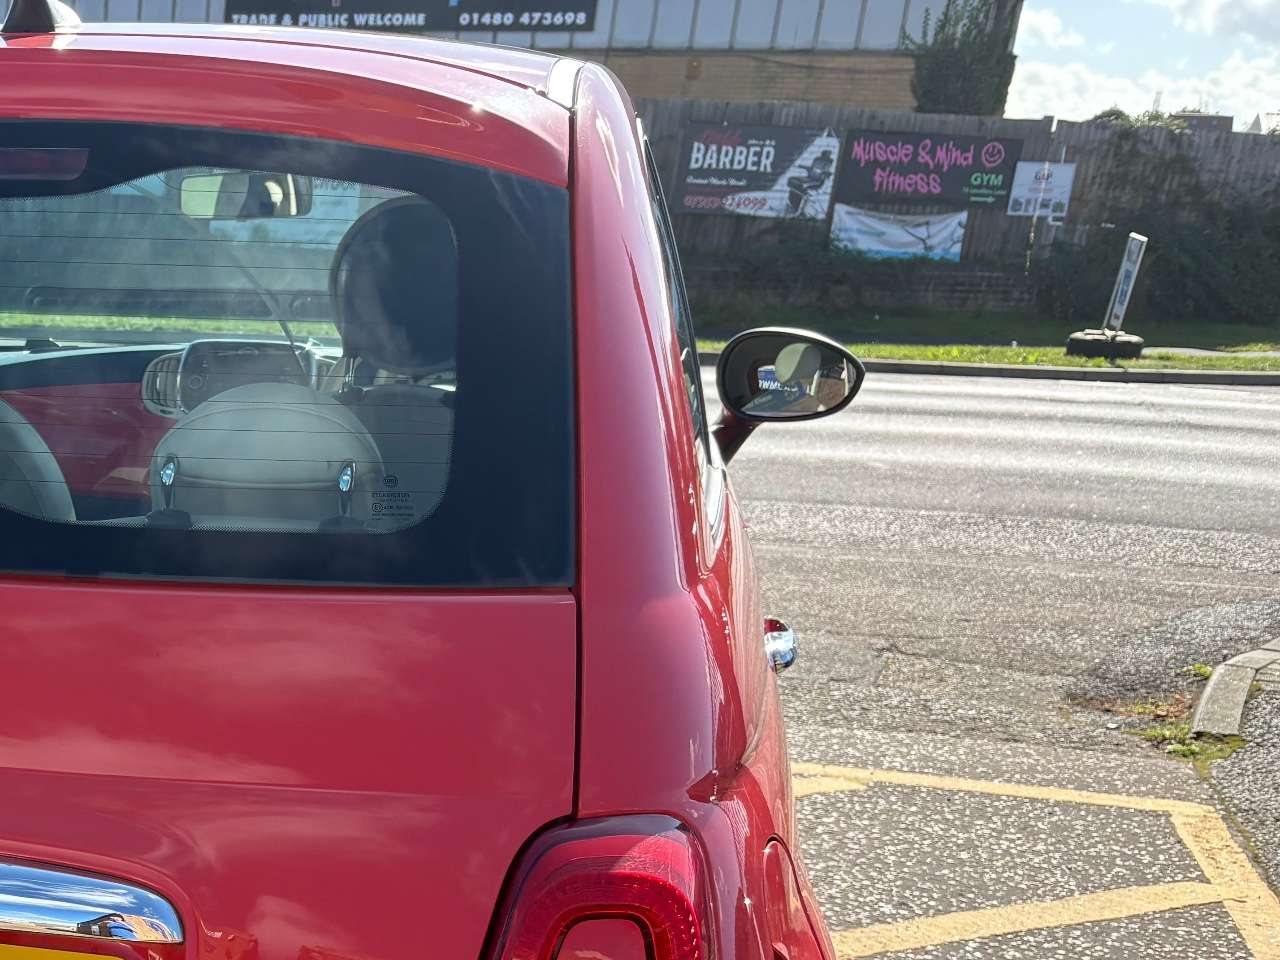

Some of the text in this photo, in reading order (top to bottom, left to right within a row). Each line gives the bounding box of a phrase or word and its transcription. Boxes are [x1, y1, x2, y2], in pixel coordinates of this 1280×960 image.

[231, 13, 426, 27] TRADE & PUBLIC WELCOME
[459, 12, 587, 25] 01480 473698
[689, 141, 775, 173] BARBER
[851, 136, 975, 172] Muscle & Mind
[970, 172, 1004, 186] GYM
